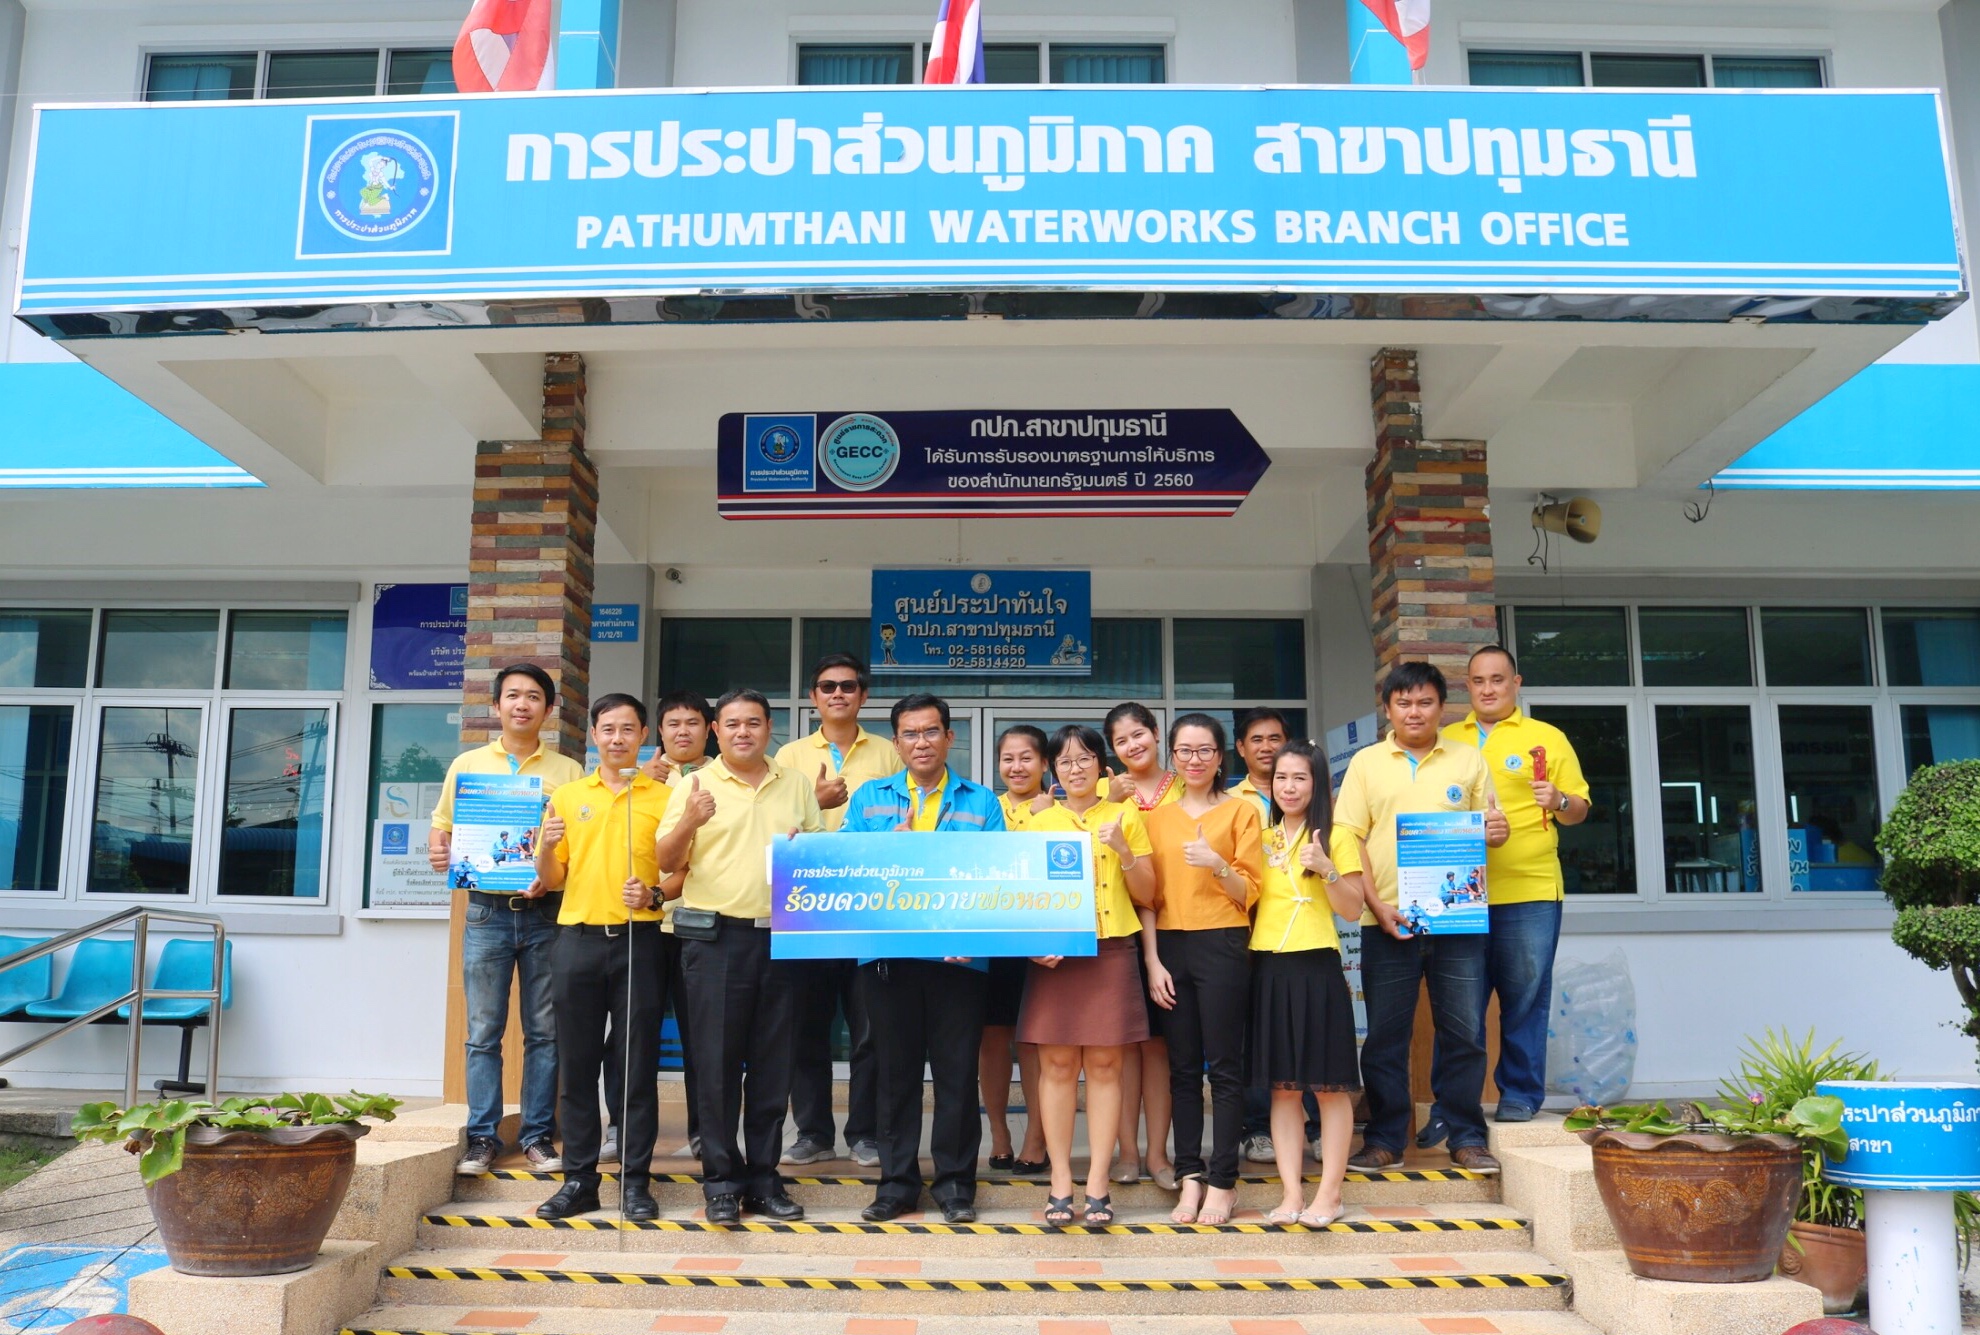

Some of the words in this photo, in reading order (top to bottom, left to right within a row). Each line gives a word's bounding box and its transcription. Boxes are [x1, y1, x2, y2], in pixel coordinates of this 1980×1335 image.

[505, 111, 1214, 192] การประปาส่วนภูมิภาค
[1253, 114, 1697, 194] สาขาปทุมธานี
[575, 211, 907, 249] PATHUMTHANI
[928, 208, 1257, 244] WATERWORKS
[1275, 210, 1461, 245] BRANCH
[1480, 211, 1630, 247] OFFICE
[970, 411, 1168, 443] กปภ.สาขาปทุมธานี
[836, 445, 884, 459] GECC
[924, 446, 1216, 466] ได้รับการรับรองมาตรฐานการให้บริการ
[948, 471, 1127, 491] ของสำนักนายกรัฐมนตรี
[1135, 471, 1146, 487] ปี
[1154, 473, 1194, 487] 2560
[894, 588, 1068, 622] ศูนย์ประปาทันใจ
[906, 619, 1056, 643] กปภ.สาขาปทุมธานี
[923, 642, 945, 655] โทร.
[948, 644, 1026, 655] 02-5816656
[948, 657, 1026, 668] 02-5814420
[792, 864, 925, 882] การประปาส่วนภูมิภาค
[784, 879, 1083, 913] ร้อยดวงใจถวายพ่อหลวง
[1840, 1100, 1980, 1133] ระปาส่วนภูมิภ
[1849, 1137, 1892, 1154] สาขา
